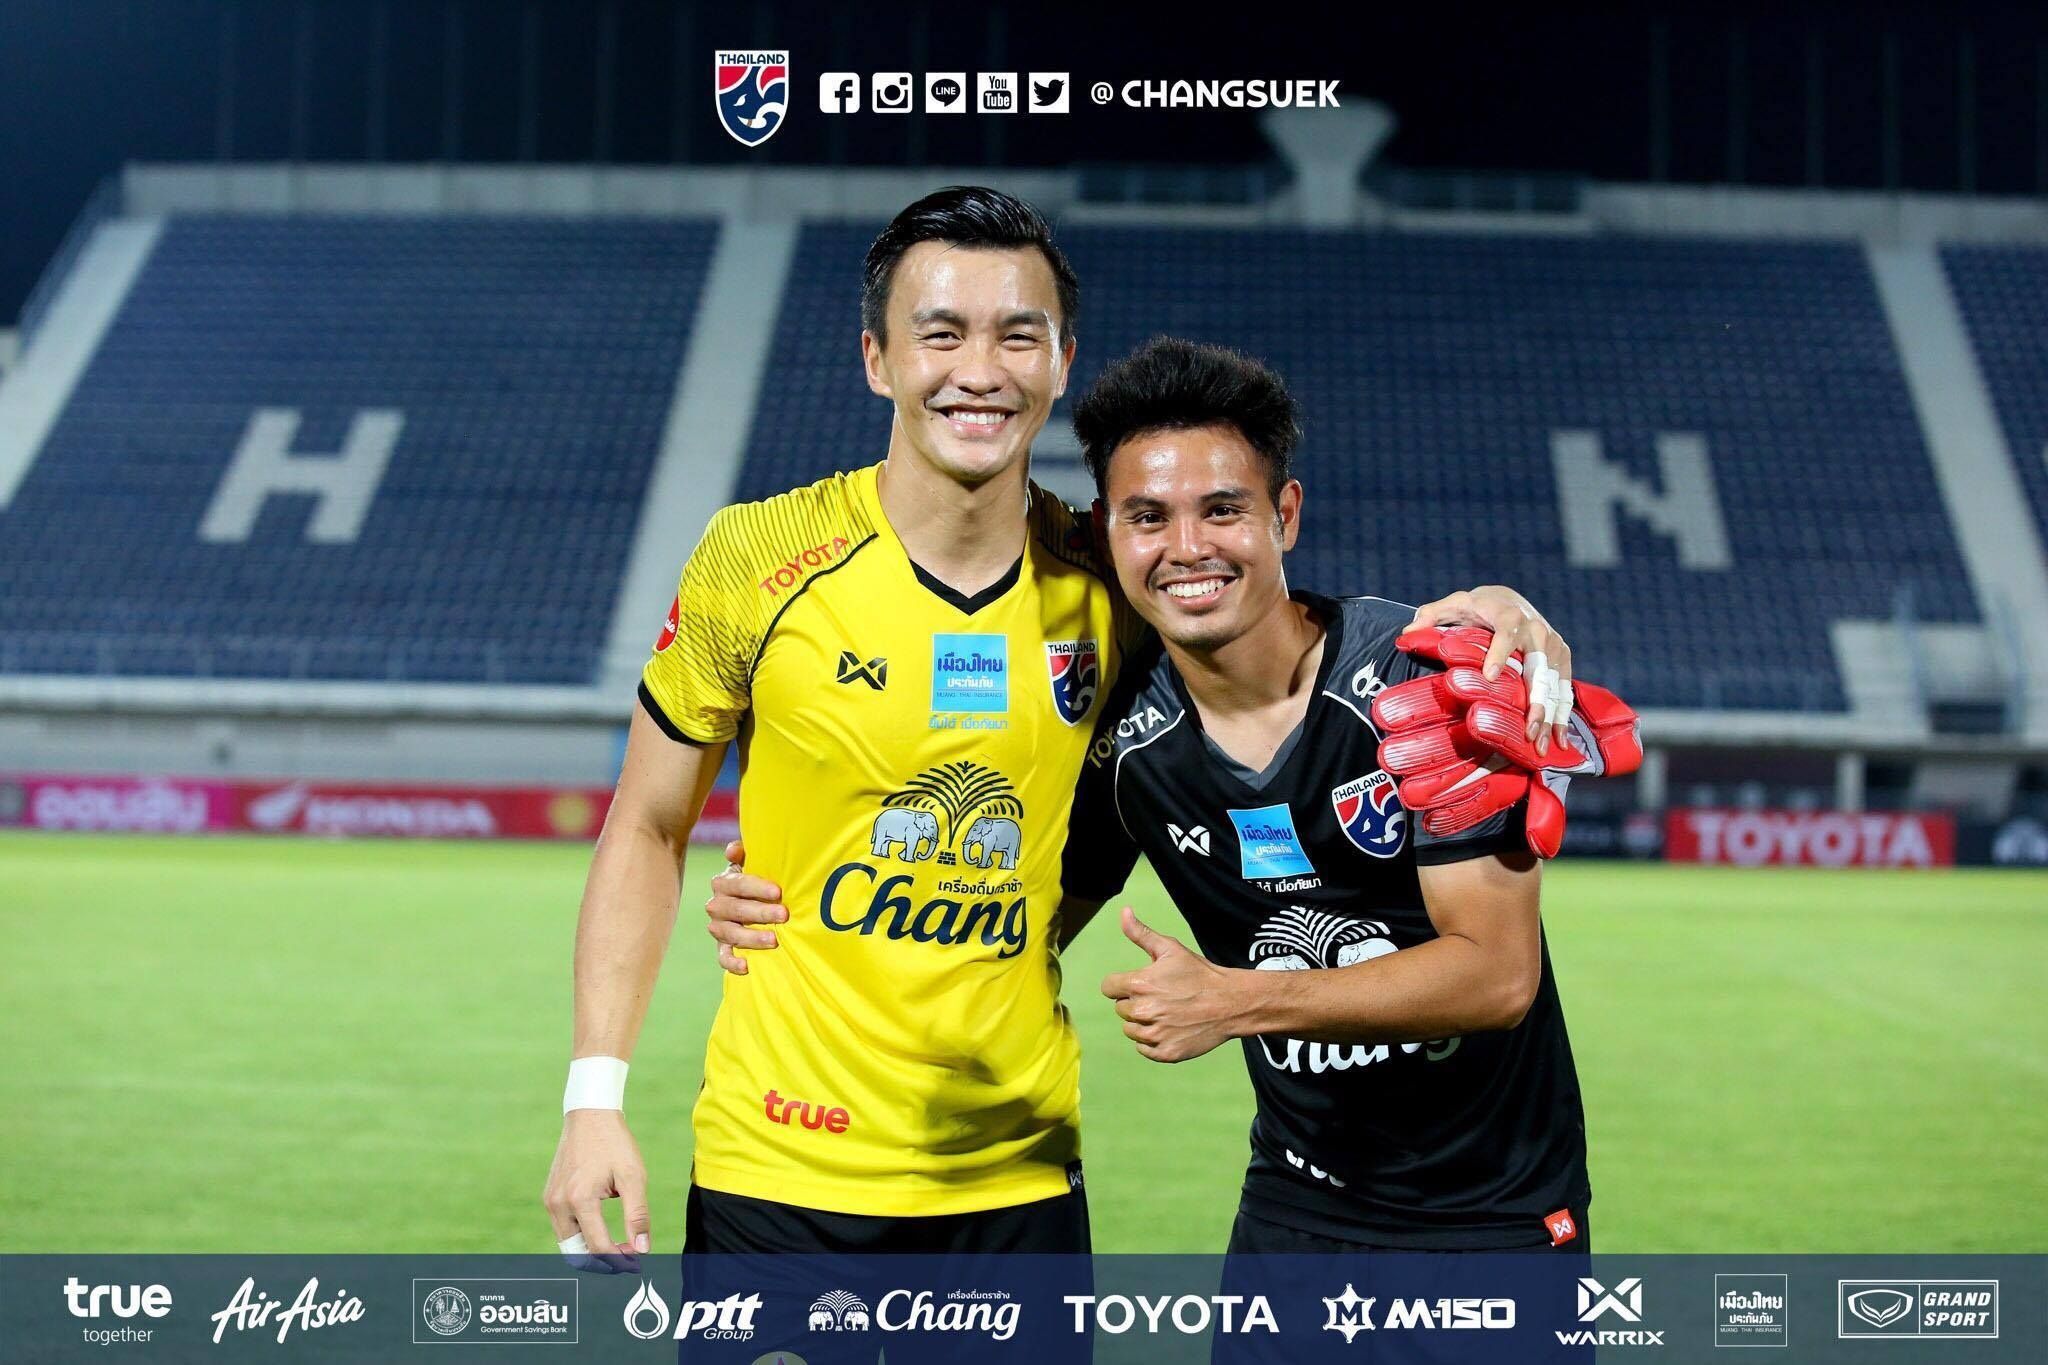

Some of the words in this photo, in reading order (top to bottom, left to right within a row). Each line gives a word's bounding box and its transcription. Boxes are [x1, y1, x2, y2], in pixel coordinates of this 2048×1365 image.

[197, 407, 404, 543] H
[1550, 431, 1733, 569] N
[759, 535, 850, 597] TOYOTA
[938, 651, 1003, 672] เมืองไทย
[1046, 642, 1096, 655] THAILAND
[1333, 772, 1389, 801] THAILAND
[1687, 812, 1933, 867] TOYOTA
[820, 862, 1028, 959] Chang
[764, 1089, 850, 1134] true
